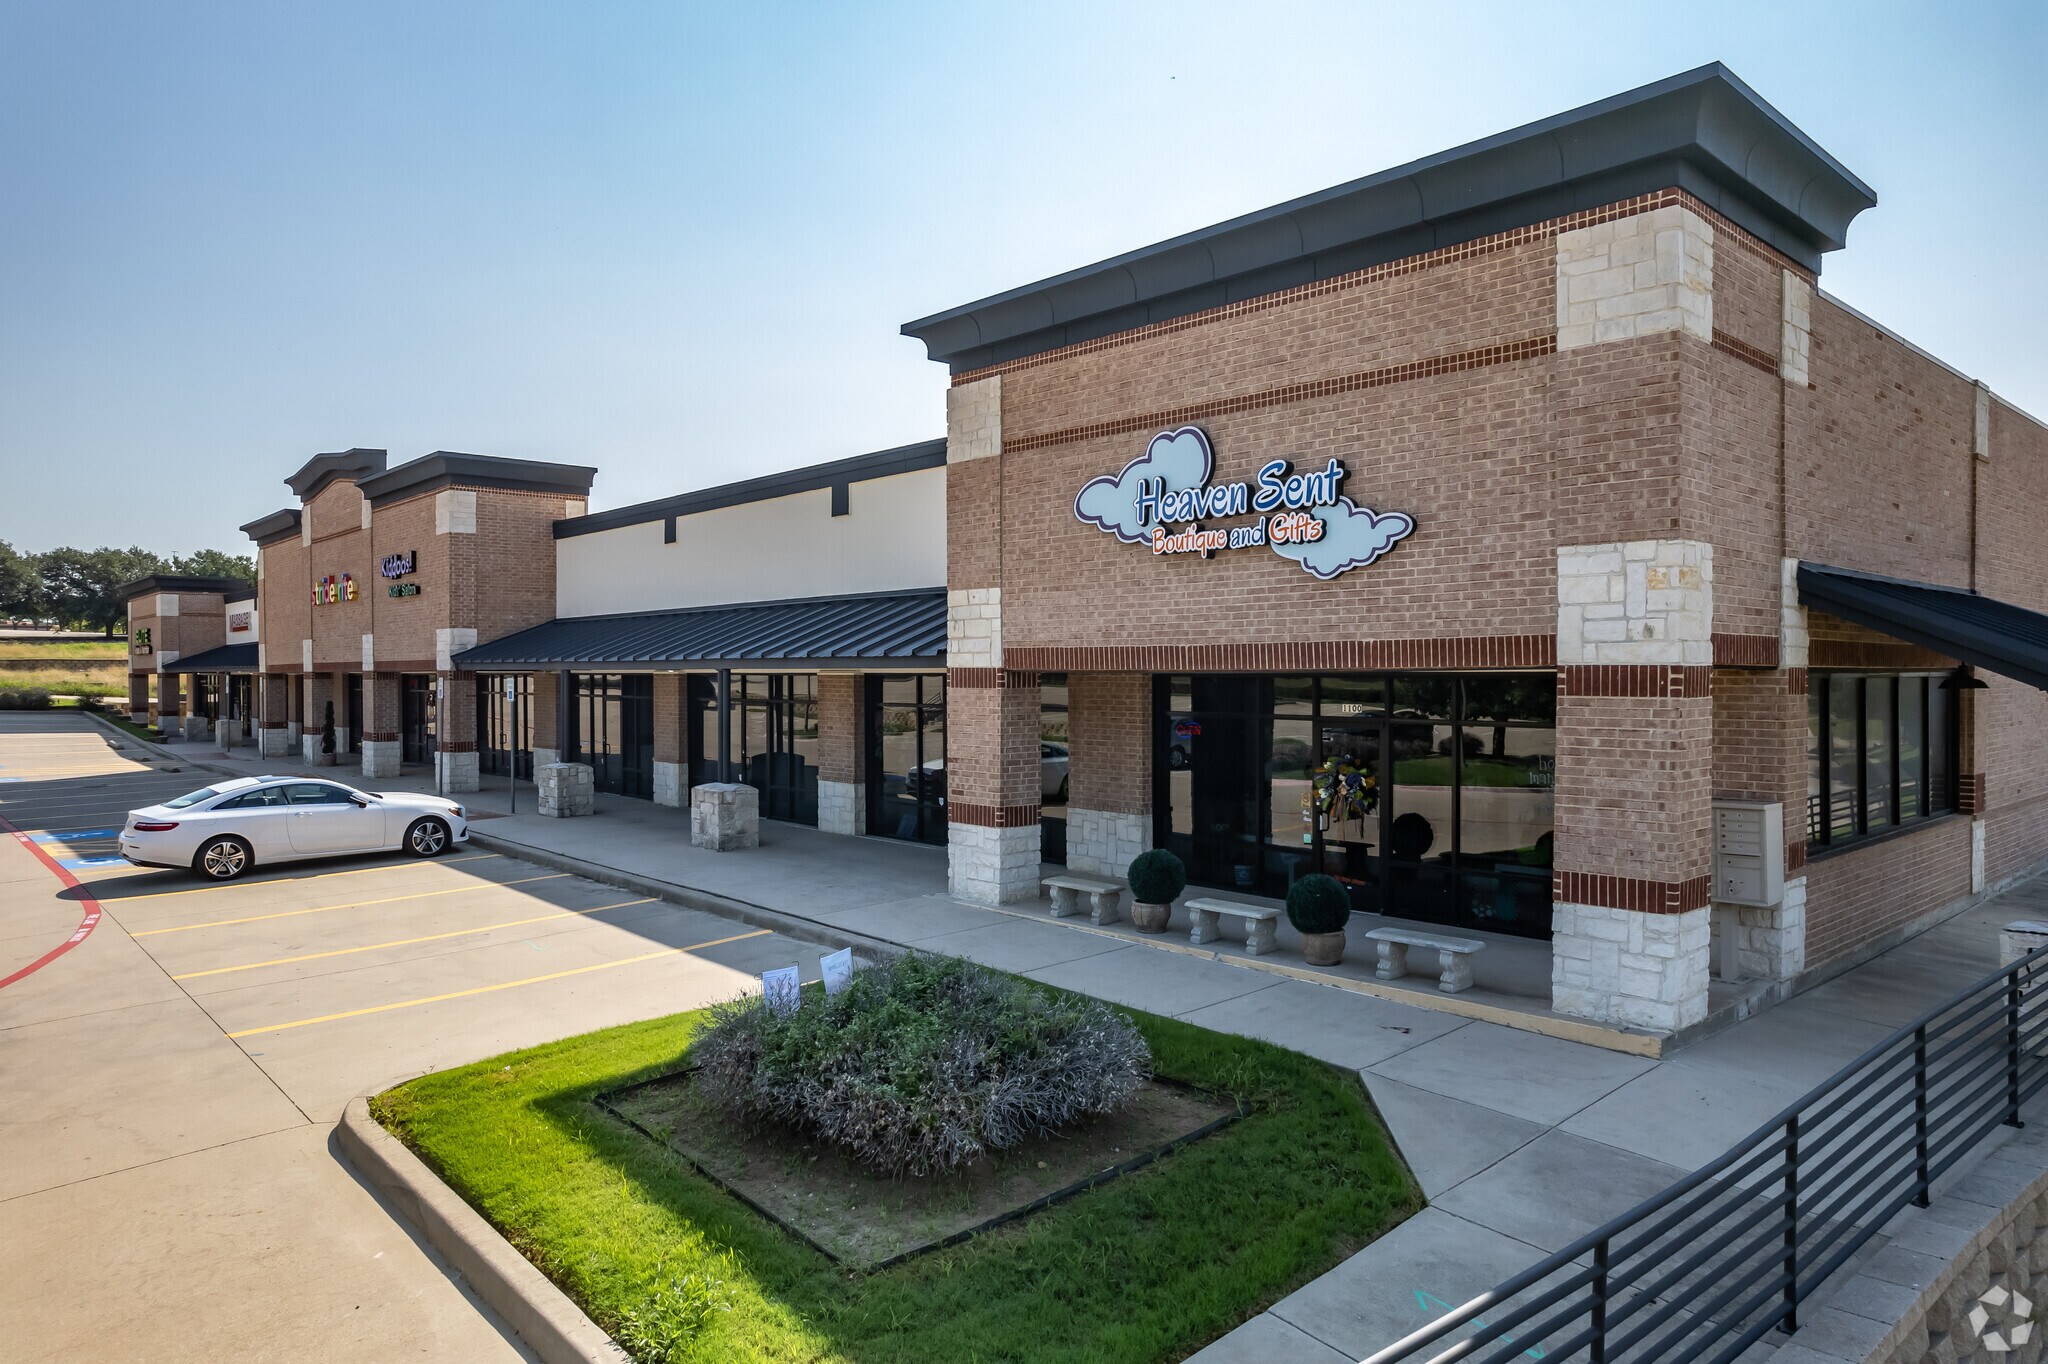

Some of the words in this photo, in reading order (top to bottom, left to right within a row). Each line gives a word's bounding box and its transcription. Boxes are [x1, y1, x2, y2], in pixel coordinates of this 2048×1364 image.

[1134, 477, 1247, 524] Heaven
[1253, 458, 1344, 511] Sent
[1151, 523, 1227, 560] Boutique
[1229, 516, 1266, 547] and
[1268, 511, 1324, 545] Gifts
[311, 575, 336, 606] stride
[337, 573, 354, 601] rite
[1343, 704, 1362, 712] 1100
